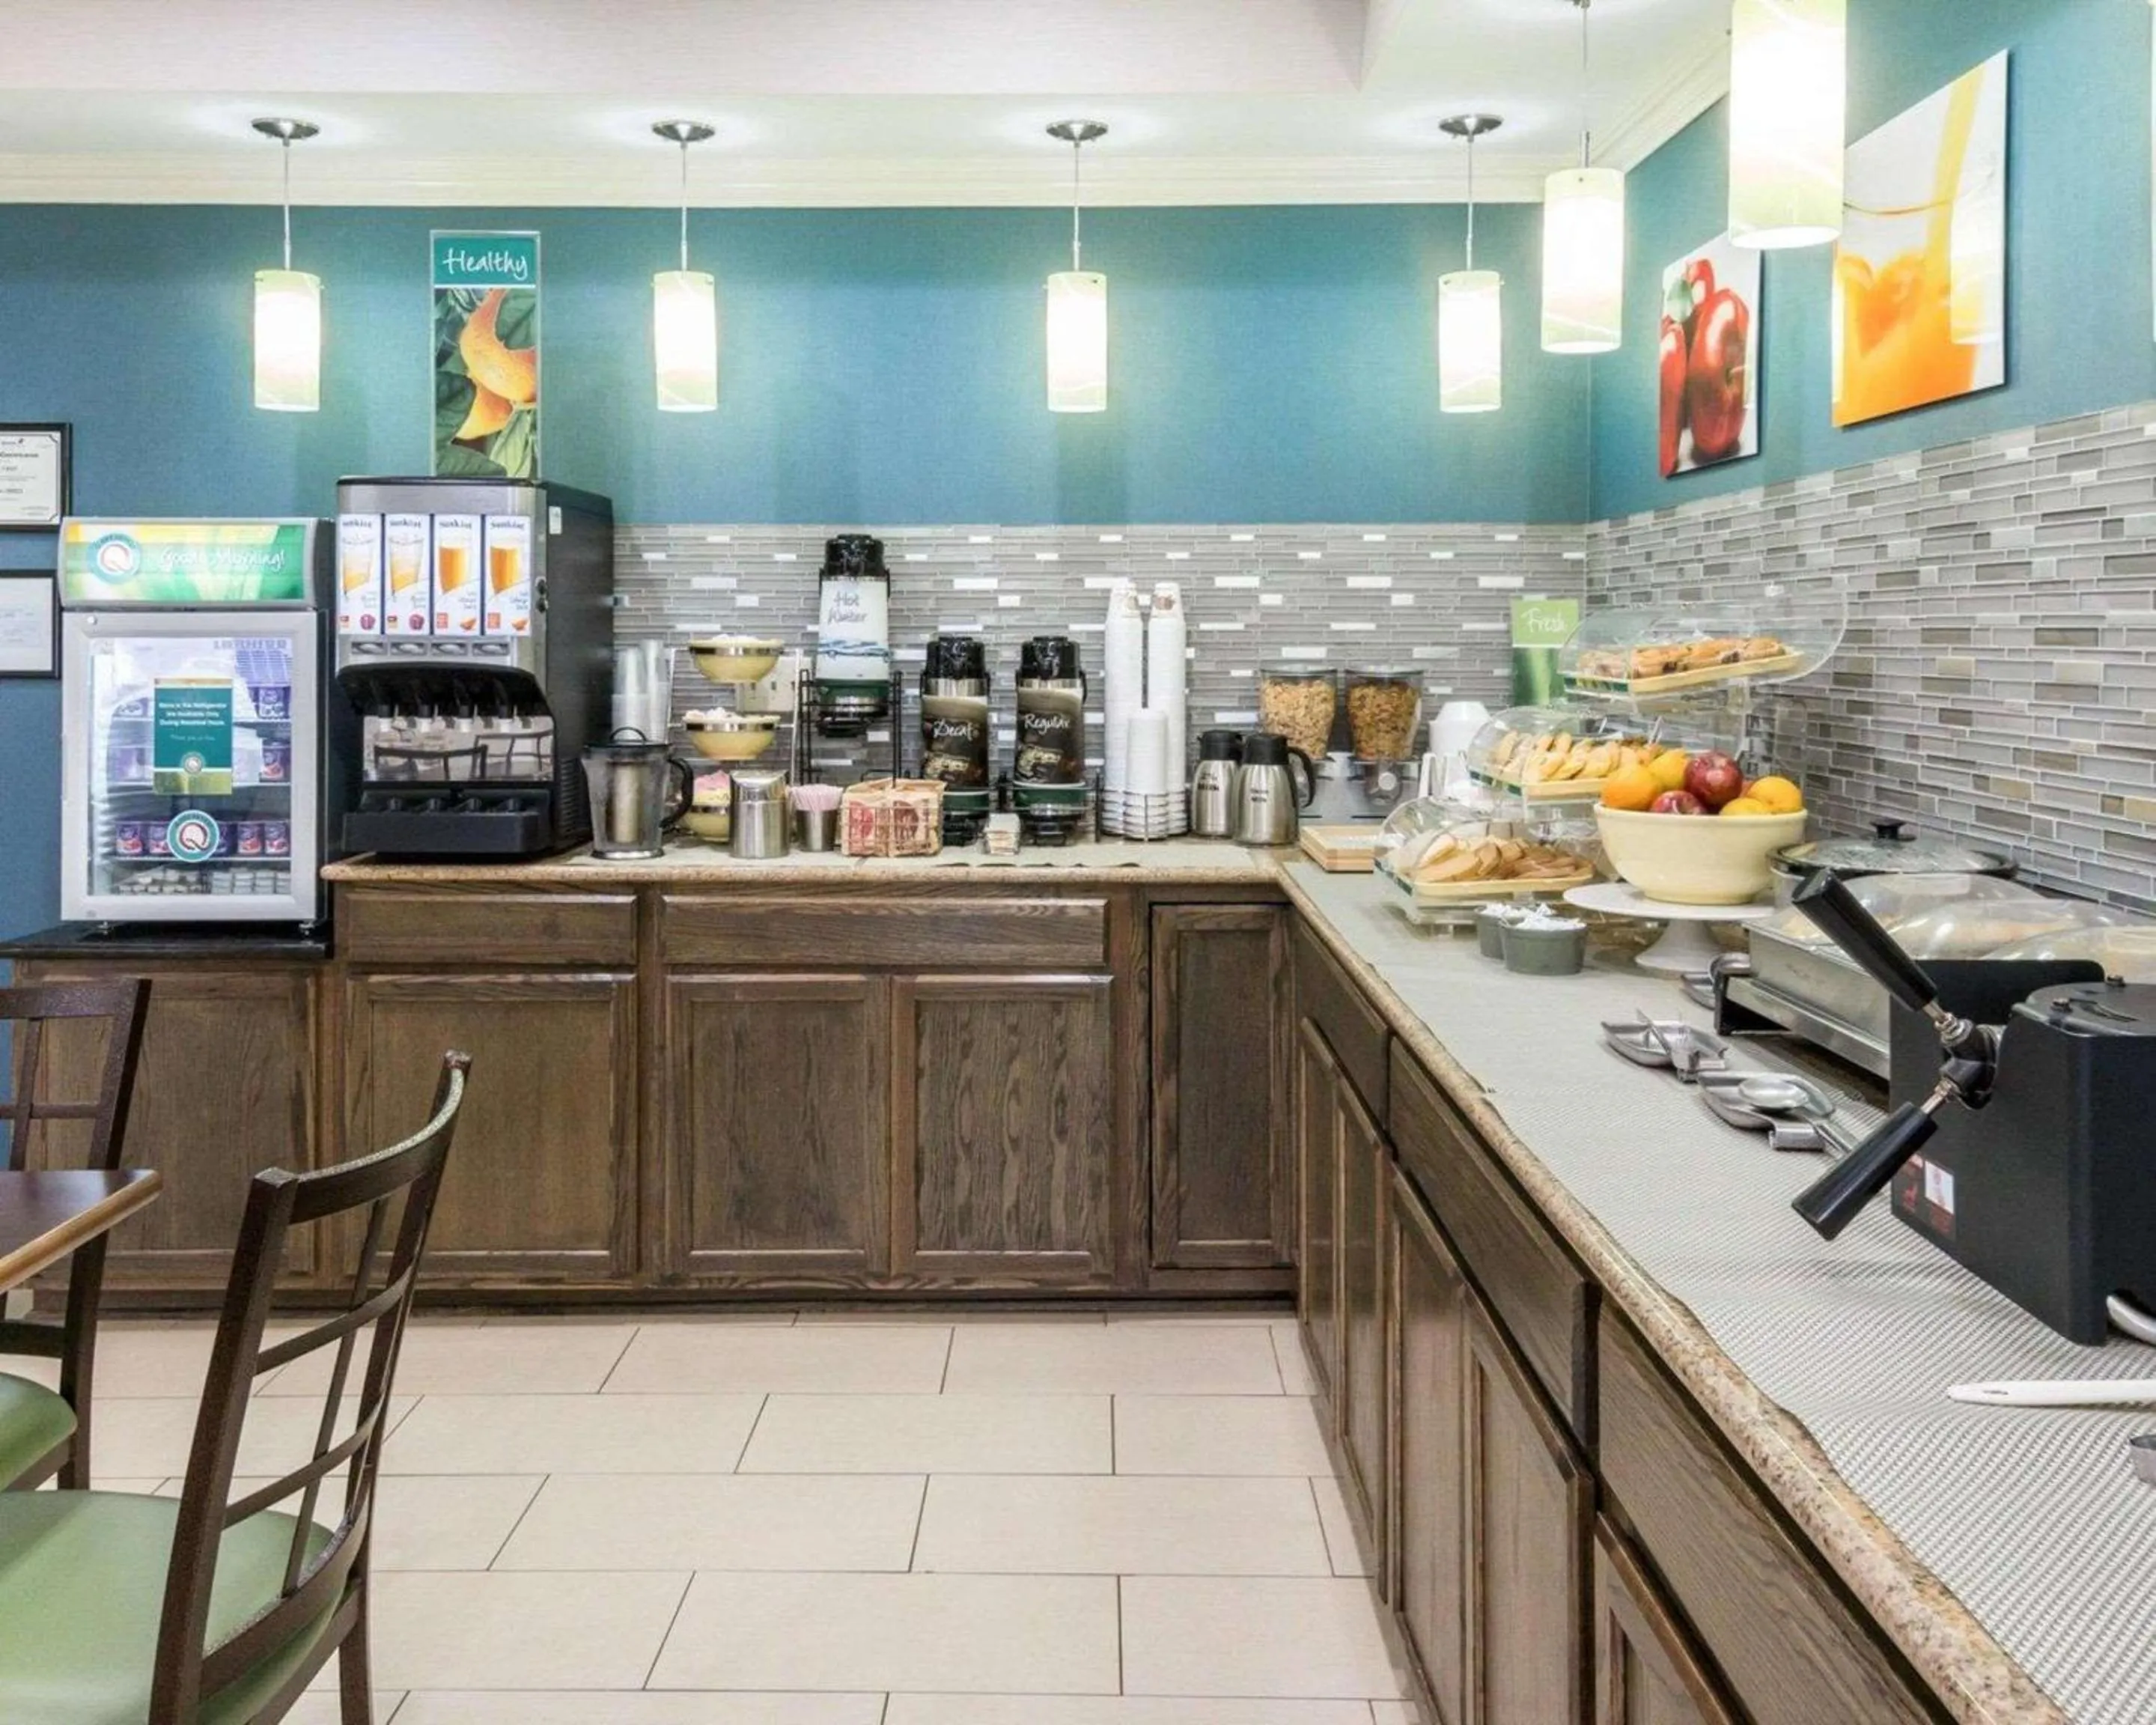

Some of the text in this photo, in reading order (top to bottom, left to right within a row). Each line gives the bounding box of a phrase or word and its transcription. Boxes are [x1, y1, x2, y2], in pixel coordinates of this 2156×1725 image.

[442, 247, 528, 281] Healthy
[833, 590, 860, 607] Hot
[1520, 607, 1566, 634] Fresh
[933, 718, 974, 742] Decaf
[1024, 714, 1071, 735] Regular
